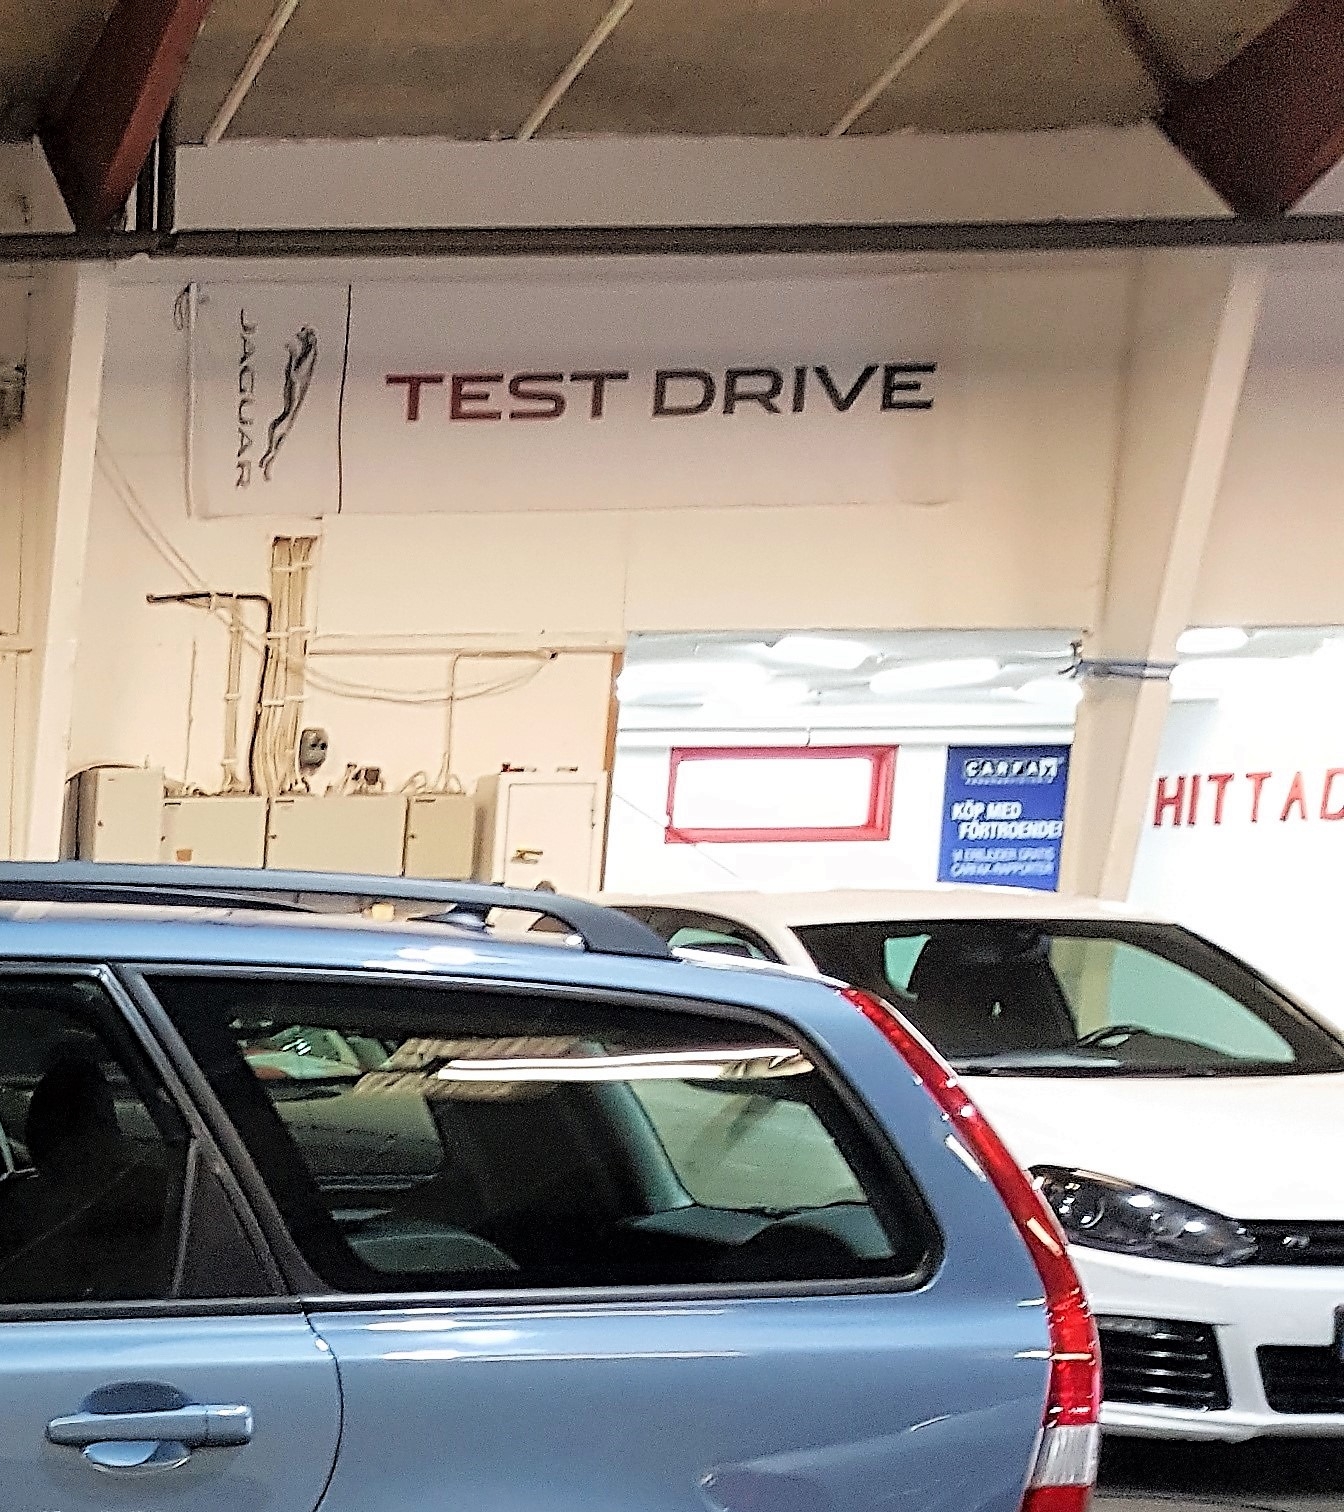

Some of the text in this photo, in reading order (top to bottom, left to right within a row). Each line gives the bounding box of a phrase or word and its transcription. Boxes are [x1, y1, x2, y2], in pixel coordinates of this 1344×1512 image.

[236, 308, 257, 488] JAGUAR
[385, 361, 938, 421] TEST DRIVE
